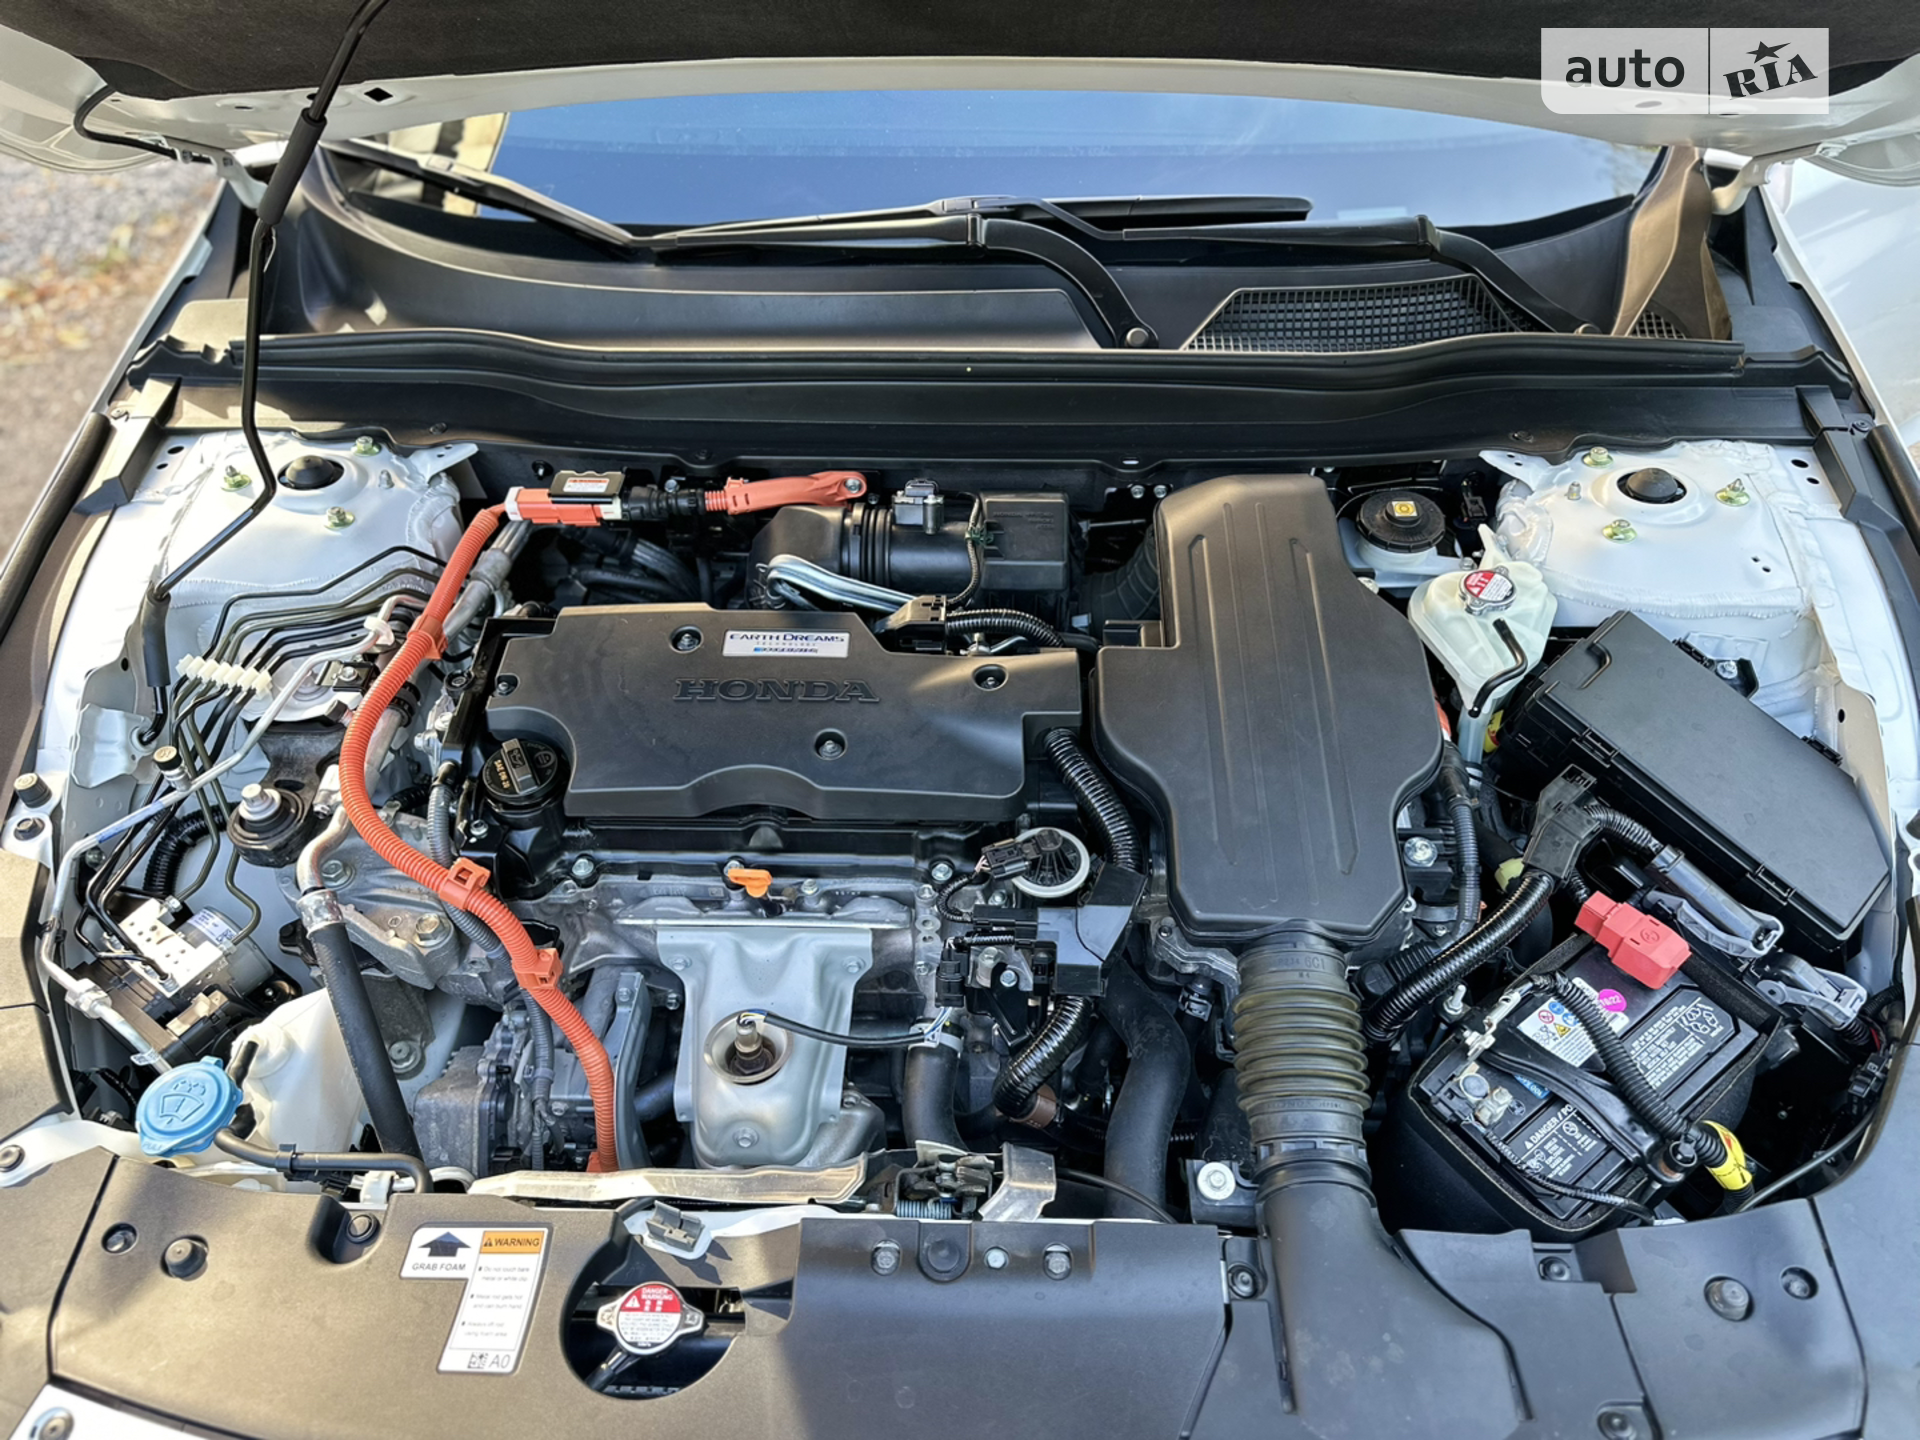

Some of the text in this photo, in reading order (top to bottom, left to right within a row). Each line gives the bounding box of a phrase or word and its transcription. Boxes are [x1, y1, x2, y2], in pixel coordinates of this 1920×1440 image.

[730, 633, 780, 641] EARTH
[673, 679, 880, 702] HONDA
[1529, 1116, 1559, 1144] DANGER
[494, 1237, 540, 1247] WARNING
[412, 1263, 466, 1271] GRAB FOAM
